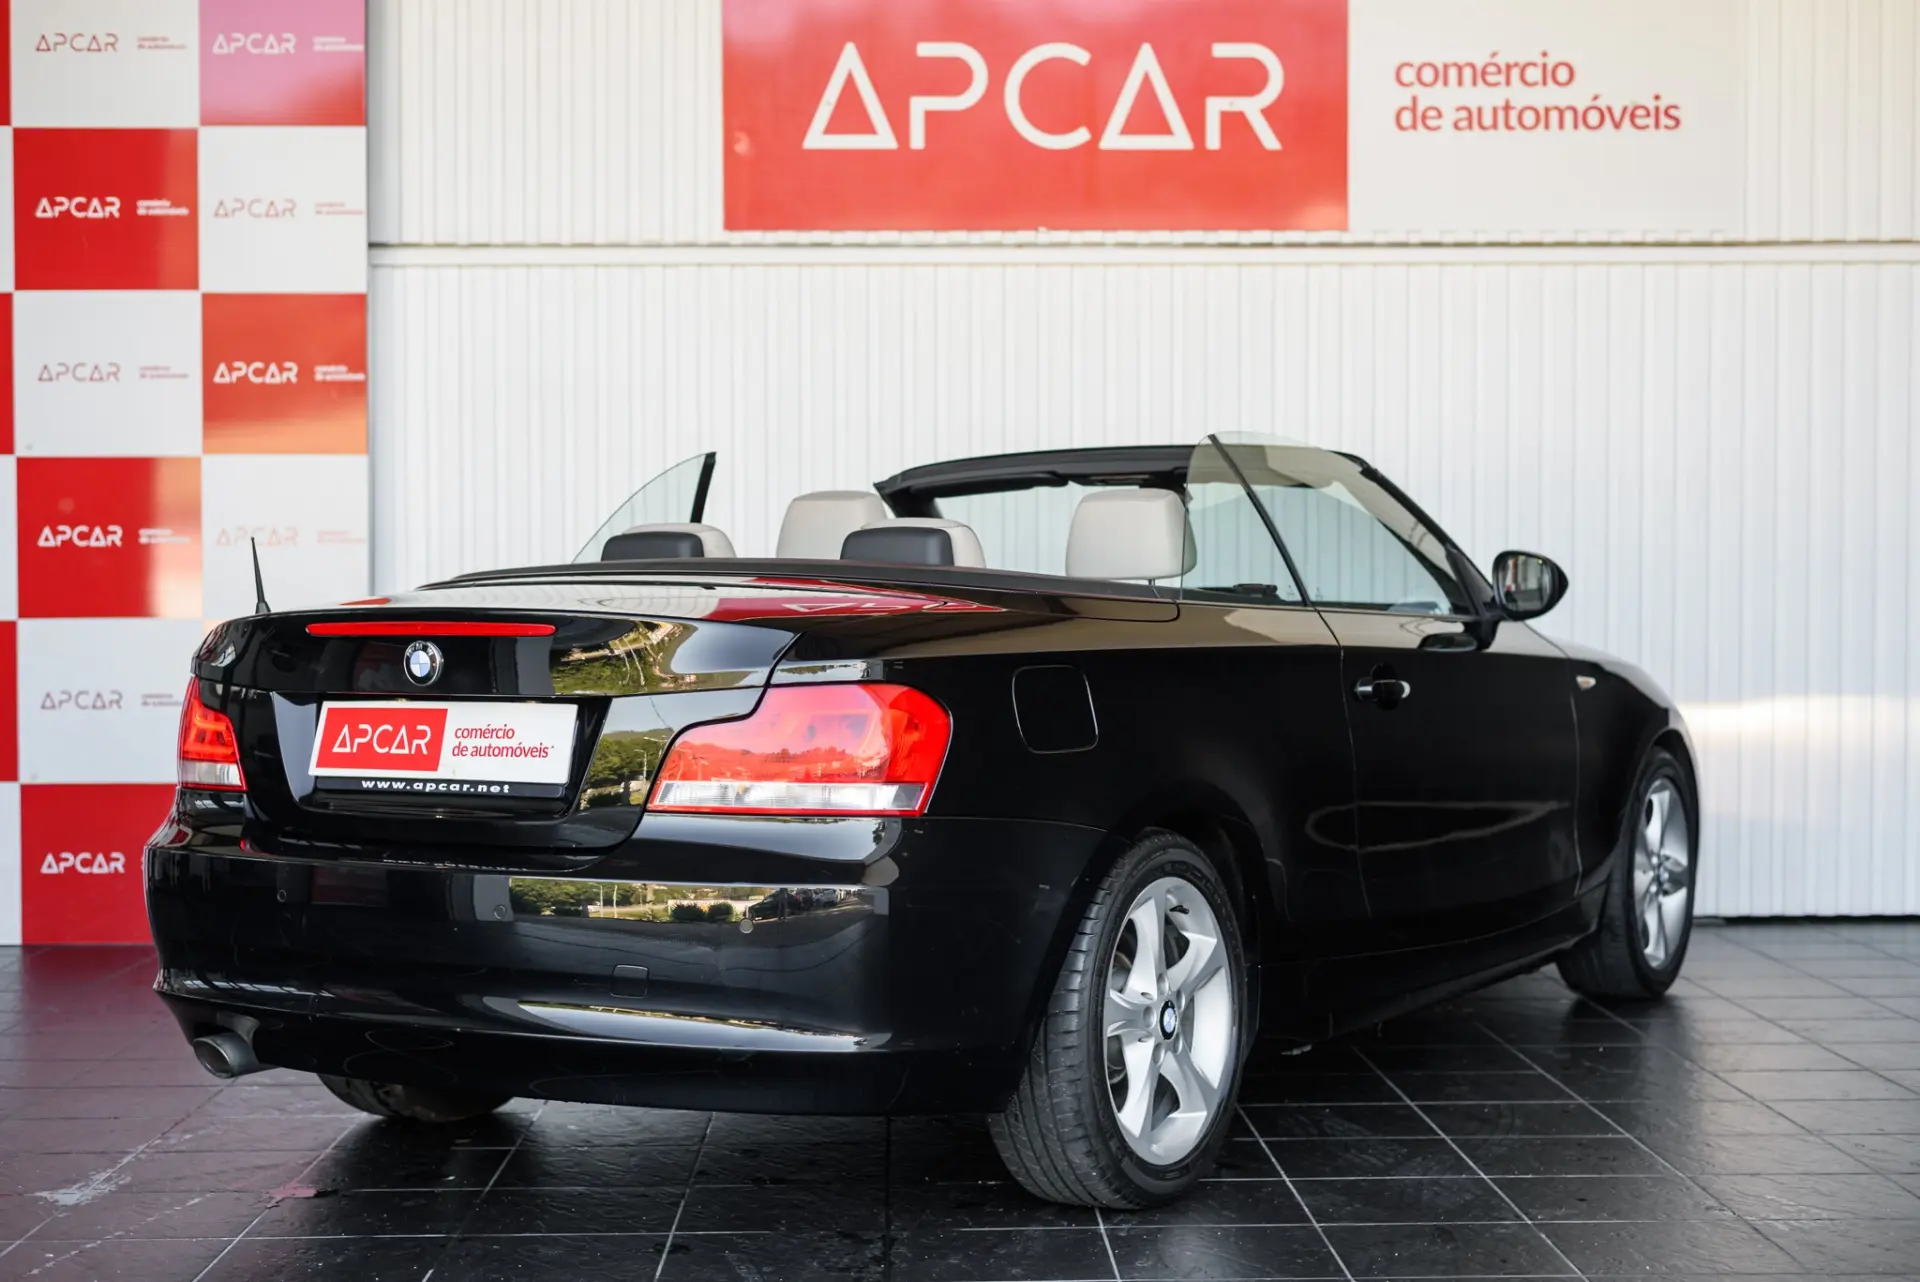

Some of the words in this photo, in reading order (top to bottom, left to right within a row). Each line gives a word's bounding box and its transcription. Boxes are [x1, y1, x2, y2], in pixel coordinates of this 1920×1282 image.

[36, 33, 119, 52] APCAR
[212, 33, 296, 54] APCAR
[1394, 50, 1576, 87] comércio
[802, 41, 1285, 150] APCAR
[1394, 95, 1443, 131] de
[1452, 94, 1681, 131] automóveis
[34, 197, 121, 218] APCAR
[213, 199, 297, 218] APCAR
[38, 362, 121, 382] APCAR
[213, 361, 299, 384] APCAR
[37, 525, 123, 547] APCAR
[40, 691, 123, 710] APCAR
[332, 723, 432, 755] APCAR
[454, 723, 515, 740] comércio
[451, 741, 468, 757] de
[470, 741, 549, 759] automóveis
[361, 779, 510, 794] www.apcar.net
[40, 852, 126, 874] APCAR
